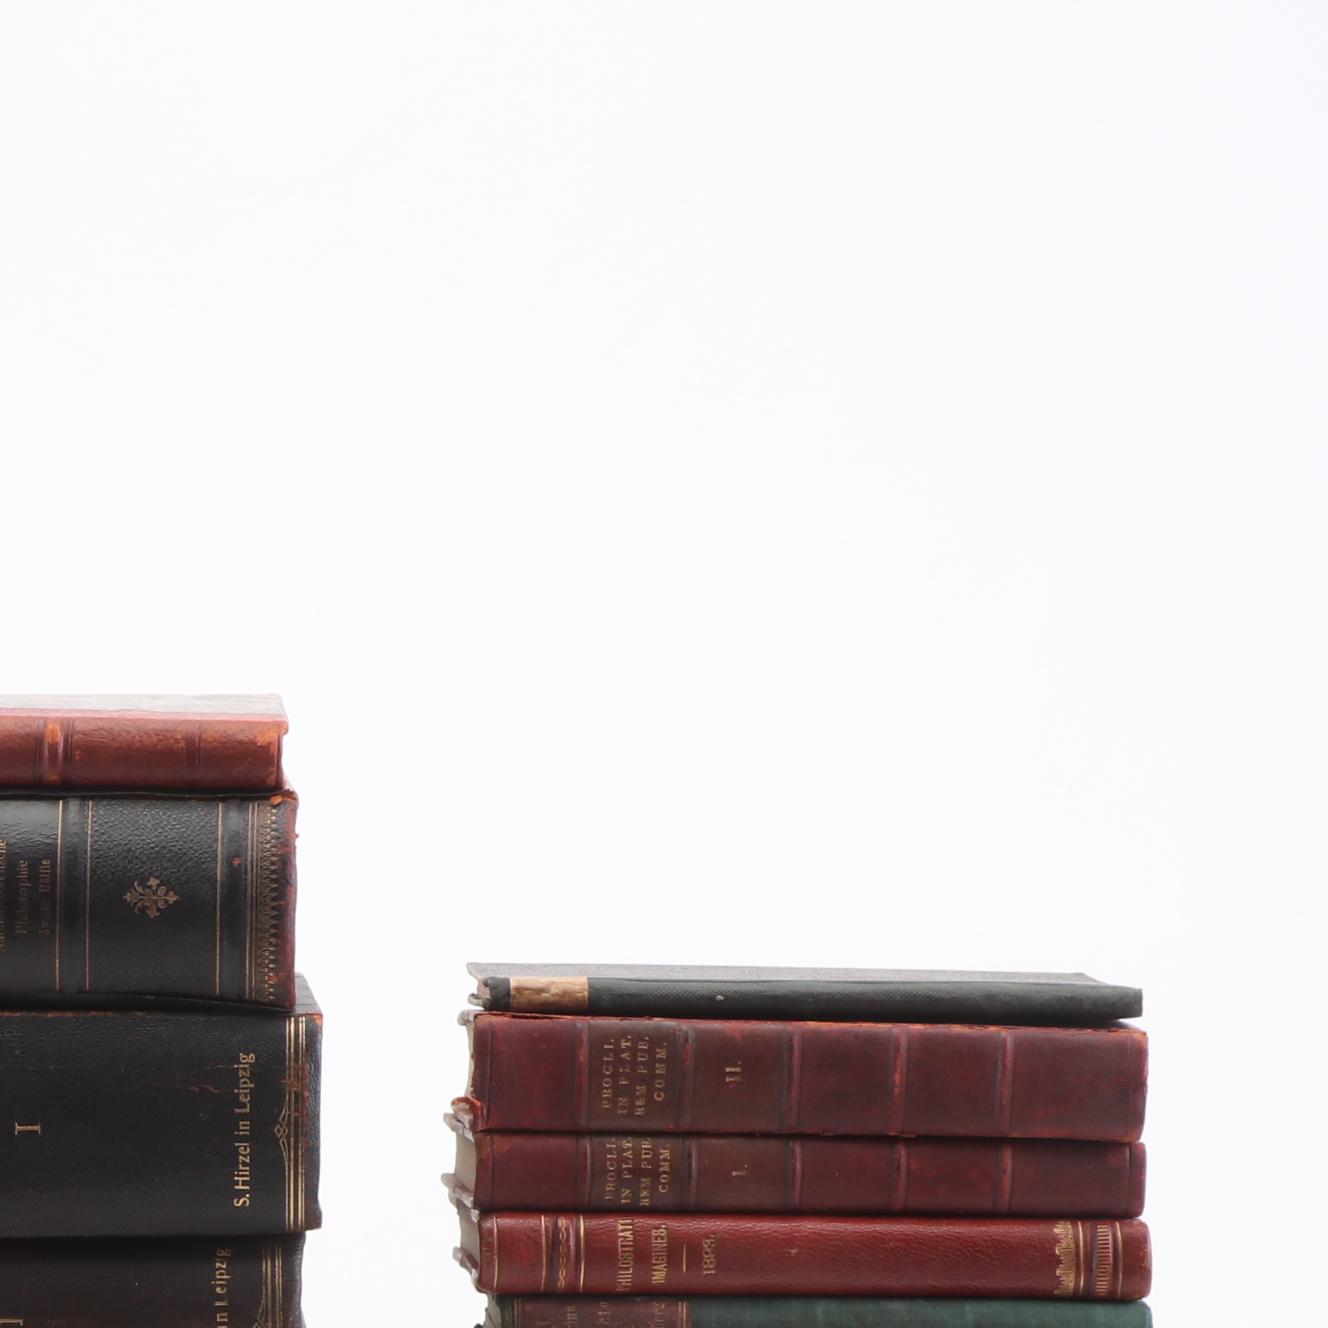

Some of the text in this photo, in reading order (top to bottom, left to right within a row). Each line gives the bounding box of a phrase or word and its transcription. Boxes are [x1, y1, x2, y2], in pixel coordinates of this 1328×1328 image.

[601, 1038, 615, 1109] PROCLI.
[617, 1035, 633, 1116] IN PLAT.
[653, 1042, 668, 1102] COMM.
[233, 1052, 256, 1208] S. Hirzel in Leipzig
[620, 1137, 634, 1205] IN PLAT.
[658, 1144, 672, 1194] COMM.
